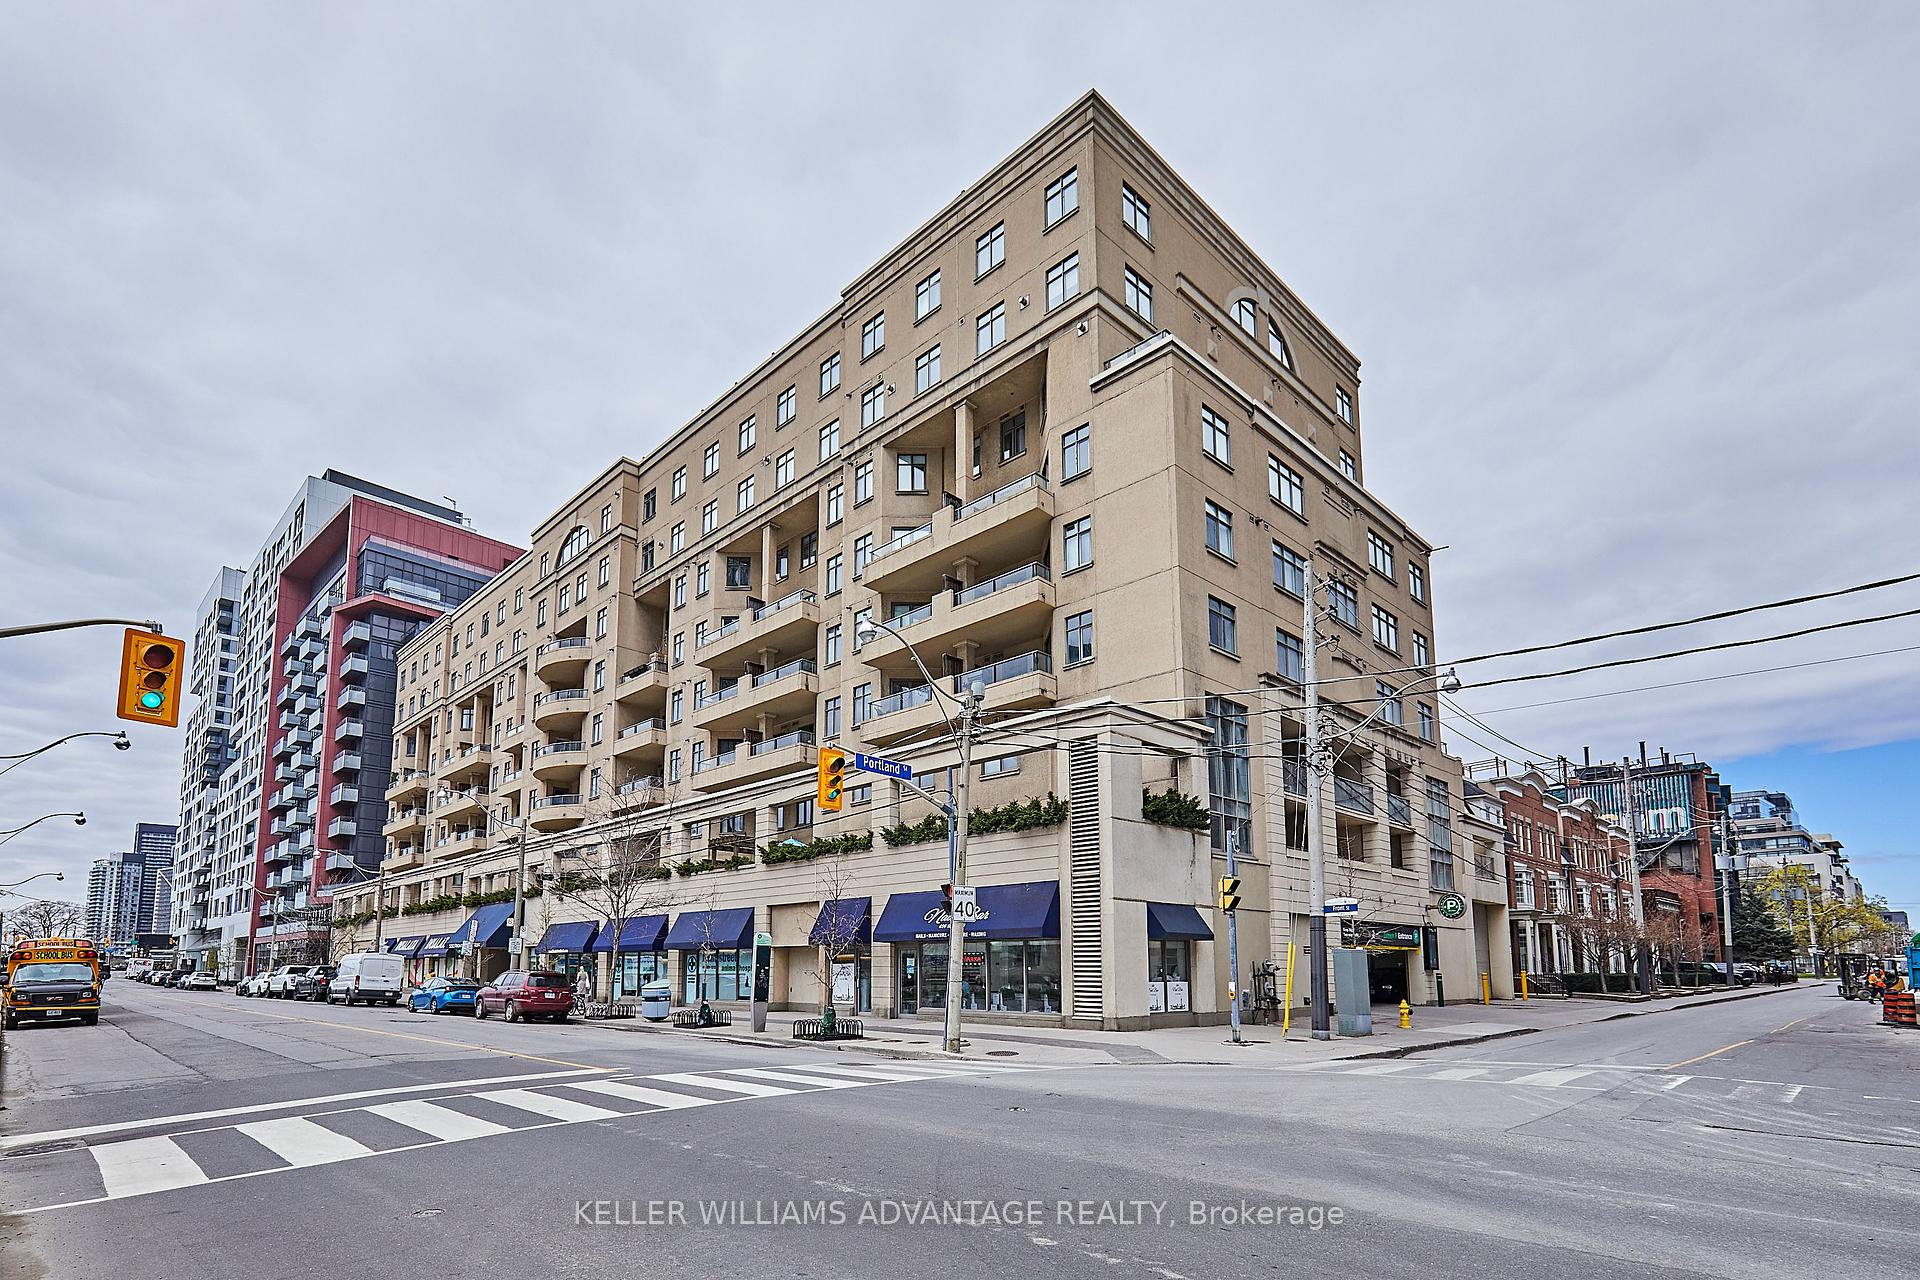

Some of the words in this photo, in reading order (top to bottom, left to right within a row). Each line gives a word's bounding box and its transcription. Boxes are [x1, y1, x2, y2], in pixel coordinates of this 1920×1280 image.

[863, 755, 900, 775] Portland
[954, 901, 974, 918] 40
[1446, 900, 1457, 910] P
[1397, 932, 1413, 940] Entrance
[35, 951, 60, 960] SCHOOL
[61, 950, 73, 959] BUS
